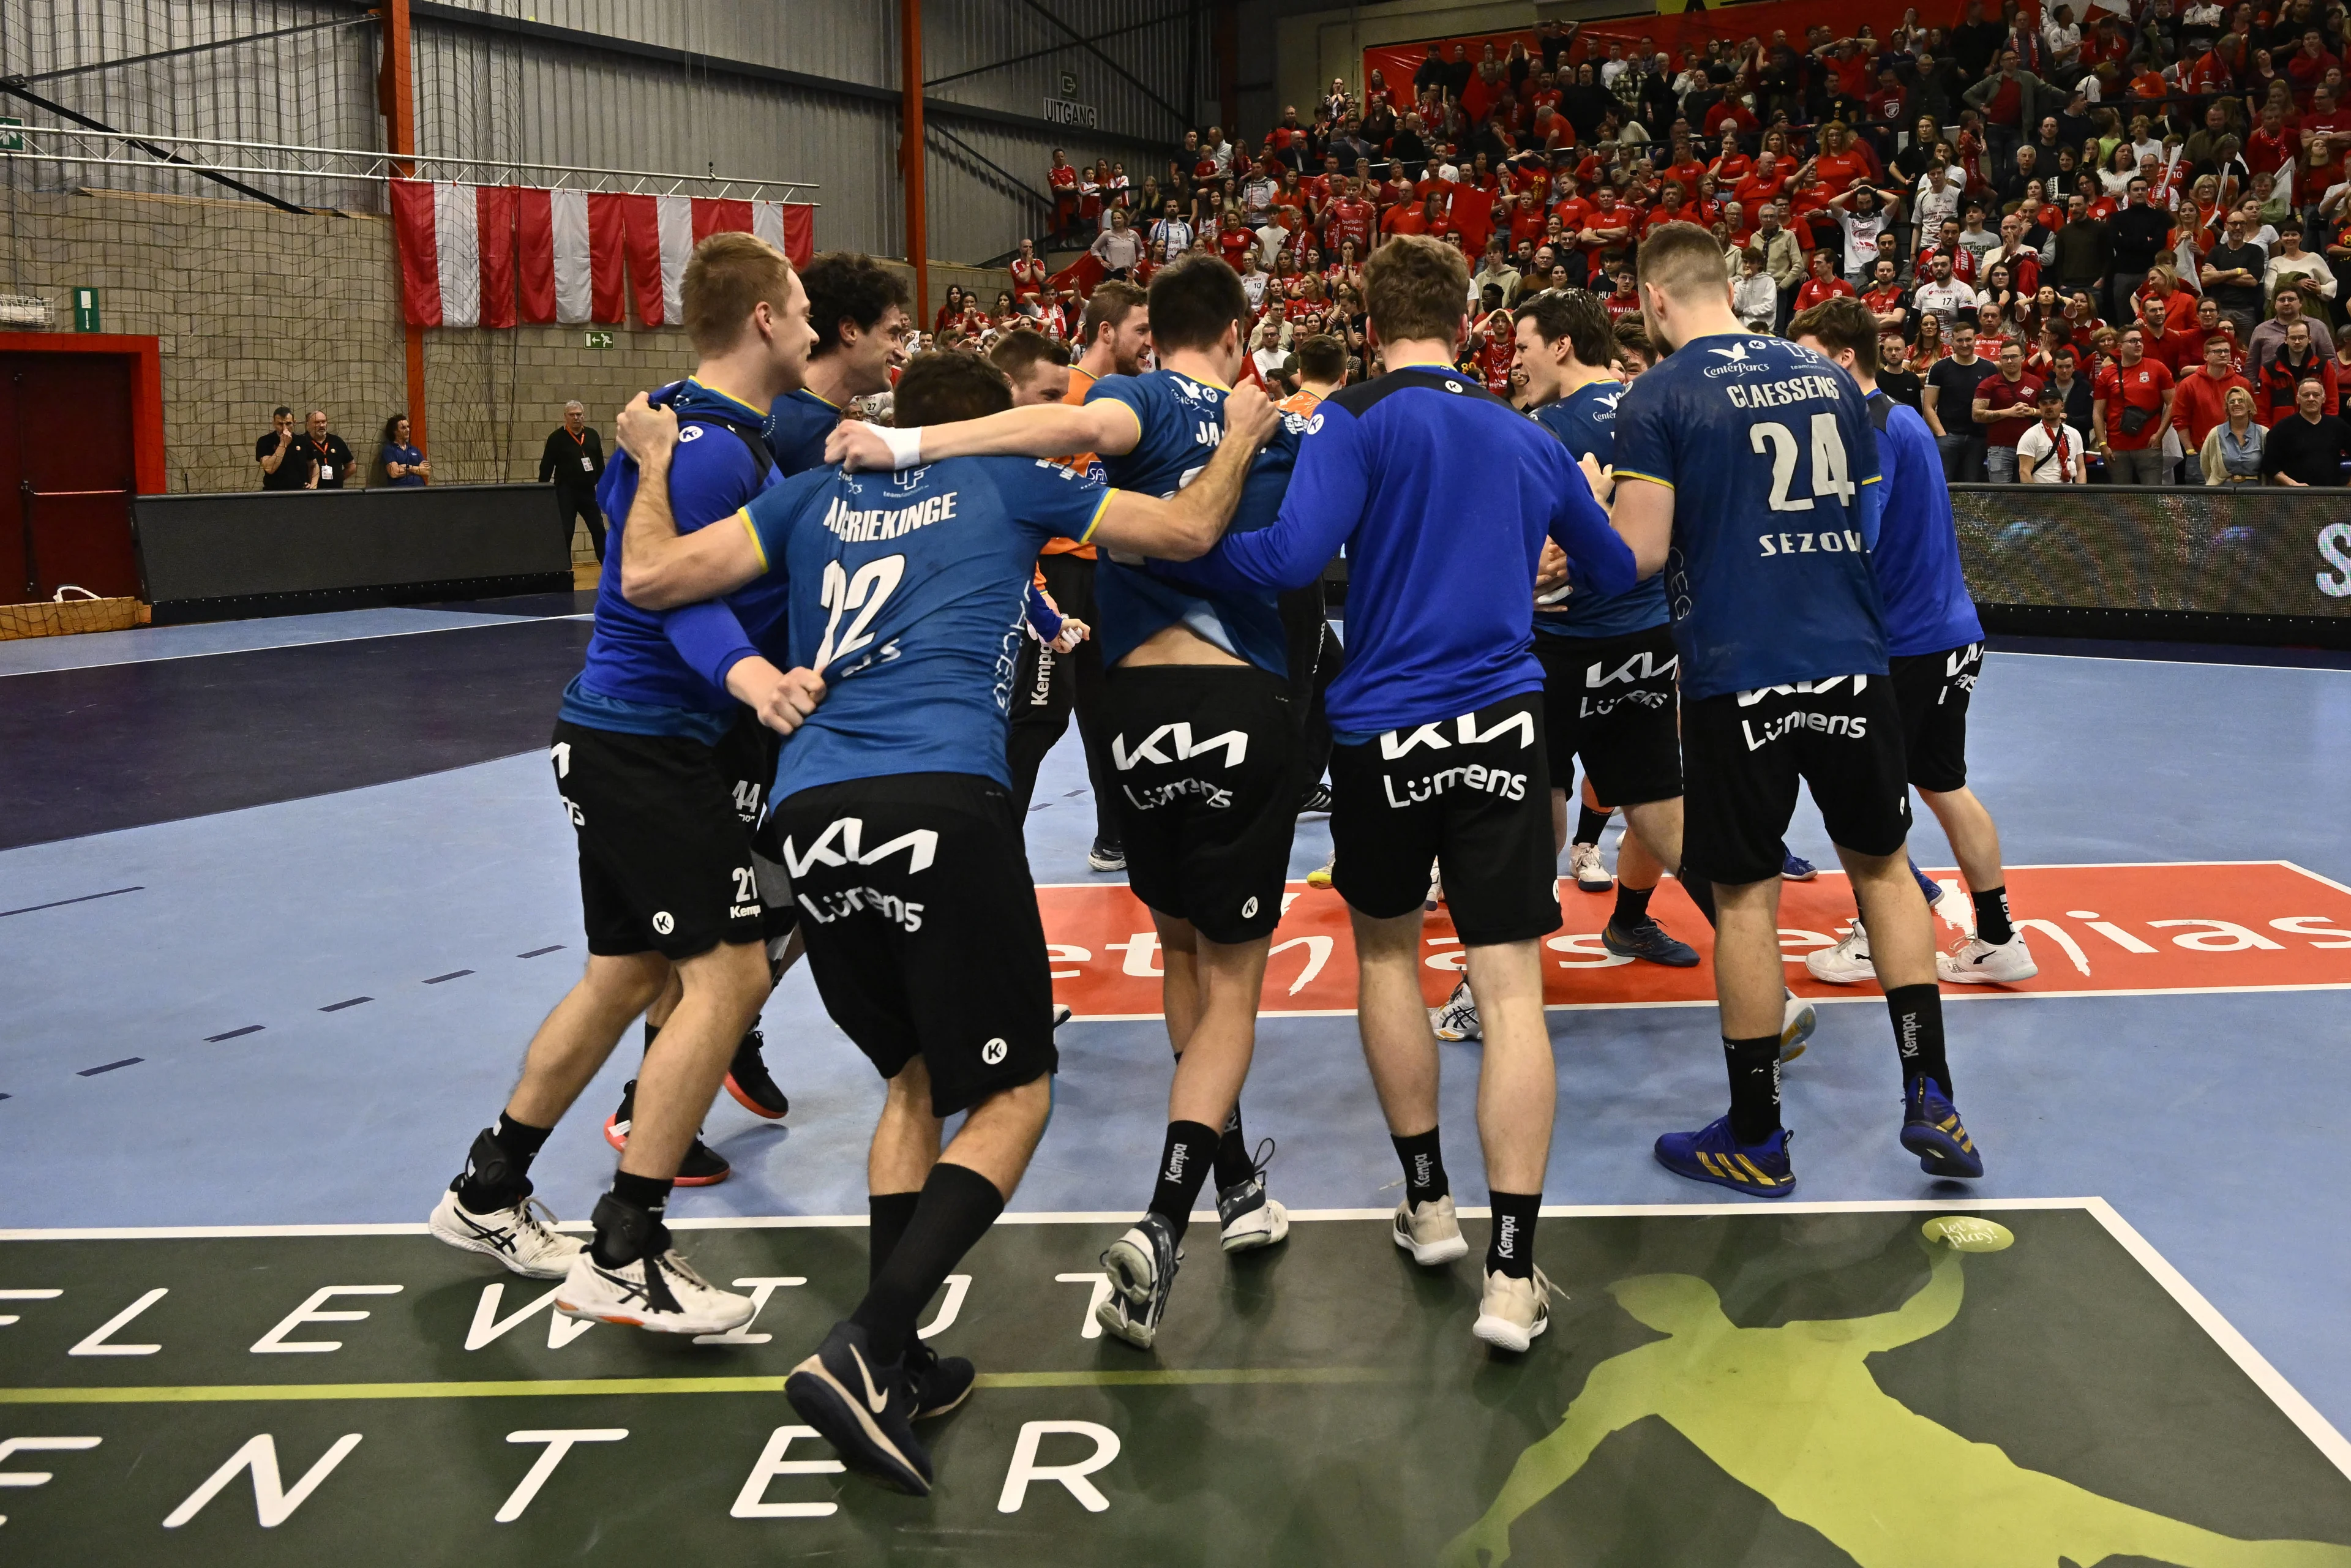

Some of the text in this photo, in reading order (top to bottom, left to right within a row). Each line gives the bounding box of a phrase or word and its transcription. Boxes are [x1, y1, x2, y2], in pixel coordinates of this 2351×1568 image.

[1045, 100, 1095, 129] UITGANG
[1726, 376, 1840, 408] CLAESSENS
[1749, 413, 1855, 512] 24
[732, 779, 761, 813] 44
[732, 866, 758, 902] 21
[1902, 1012, 1922, 1059] Kempa
[1164, 1142, 1190, 1184] Kempa
[1414, 1153, 1433, 1188] Kempa
[1498, 1215, 1520, 1259] Kempa
